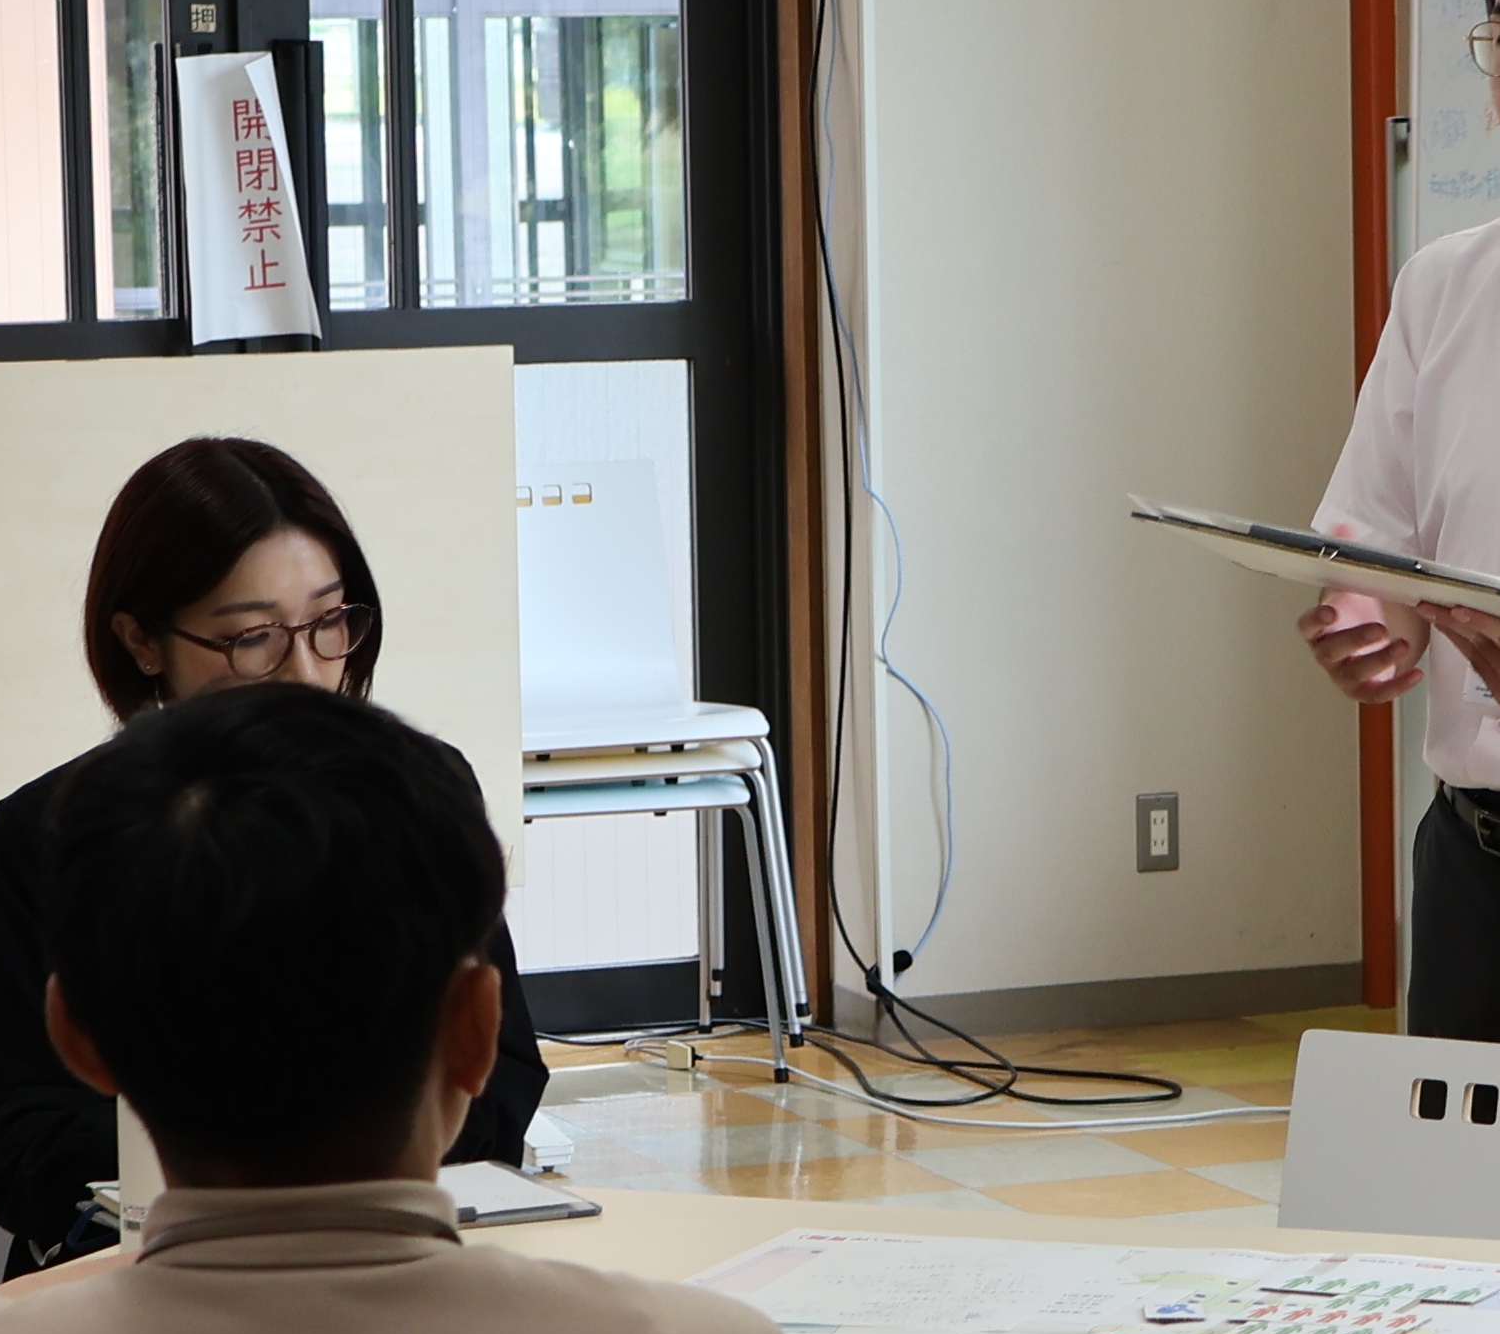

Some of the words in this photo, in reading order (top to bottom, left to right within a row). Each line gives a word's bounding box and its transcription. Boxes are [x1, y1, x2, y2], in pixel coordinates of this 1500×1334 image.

[191, 6, 216, 31] 押
[232, 99, 287, 291] 開閉禁止
